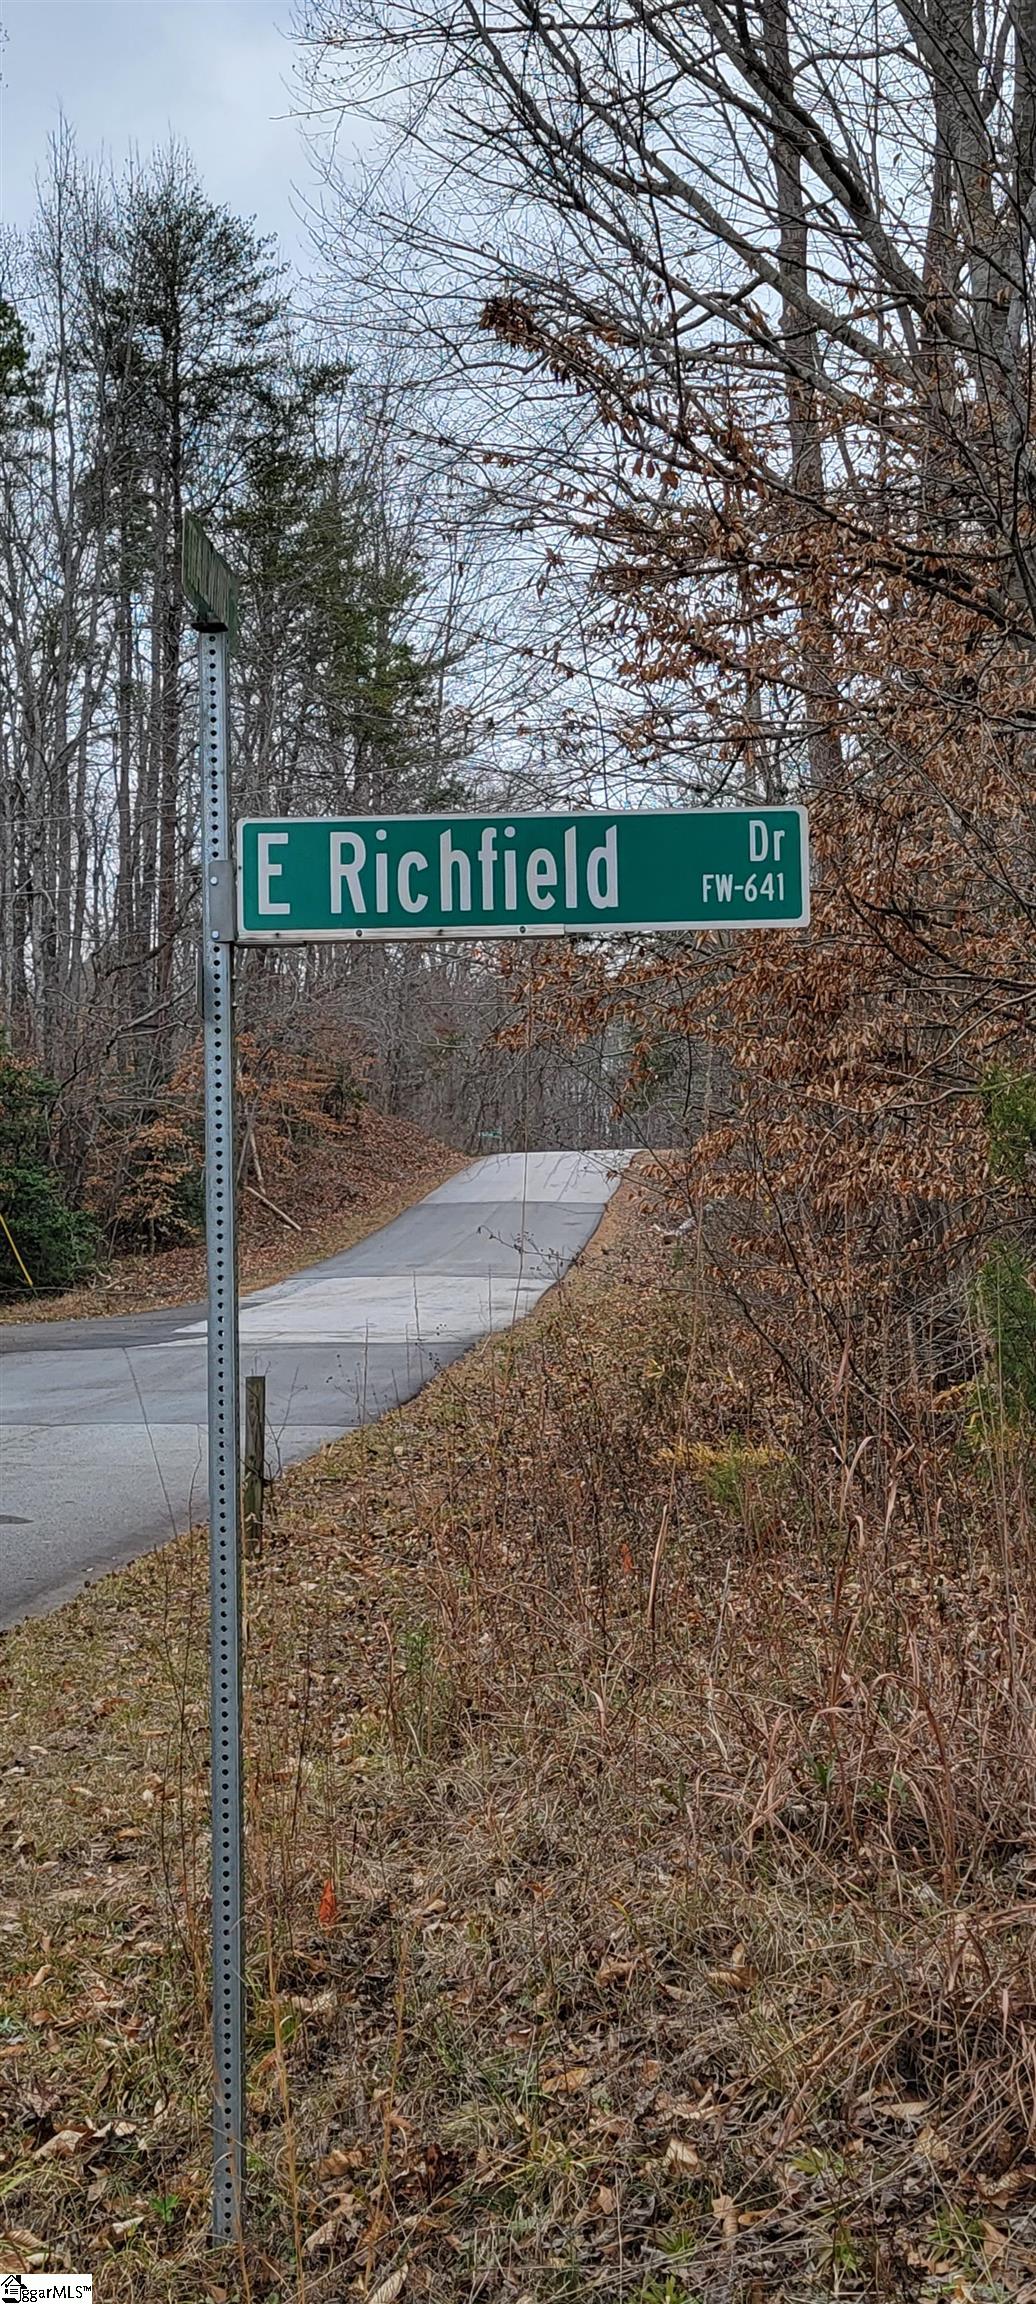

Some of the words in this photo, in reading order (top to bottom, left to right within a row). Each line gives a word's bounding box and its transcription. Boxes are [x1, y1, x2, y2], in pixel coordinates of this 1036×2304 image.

[257, 832, 291, 915] E
[330, 825, 619, 914] Richfield
[749, 820, 786, 862] Dr
[702, 873, 785, 903] FW-641
